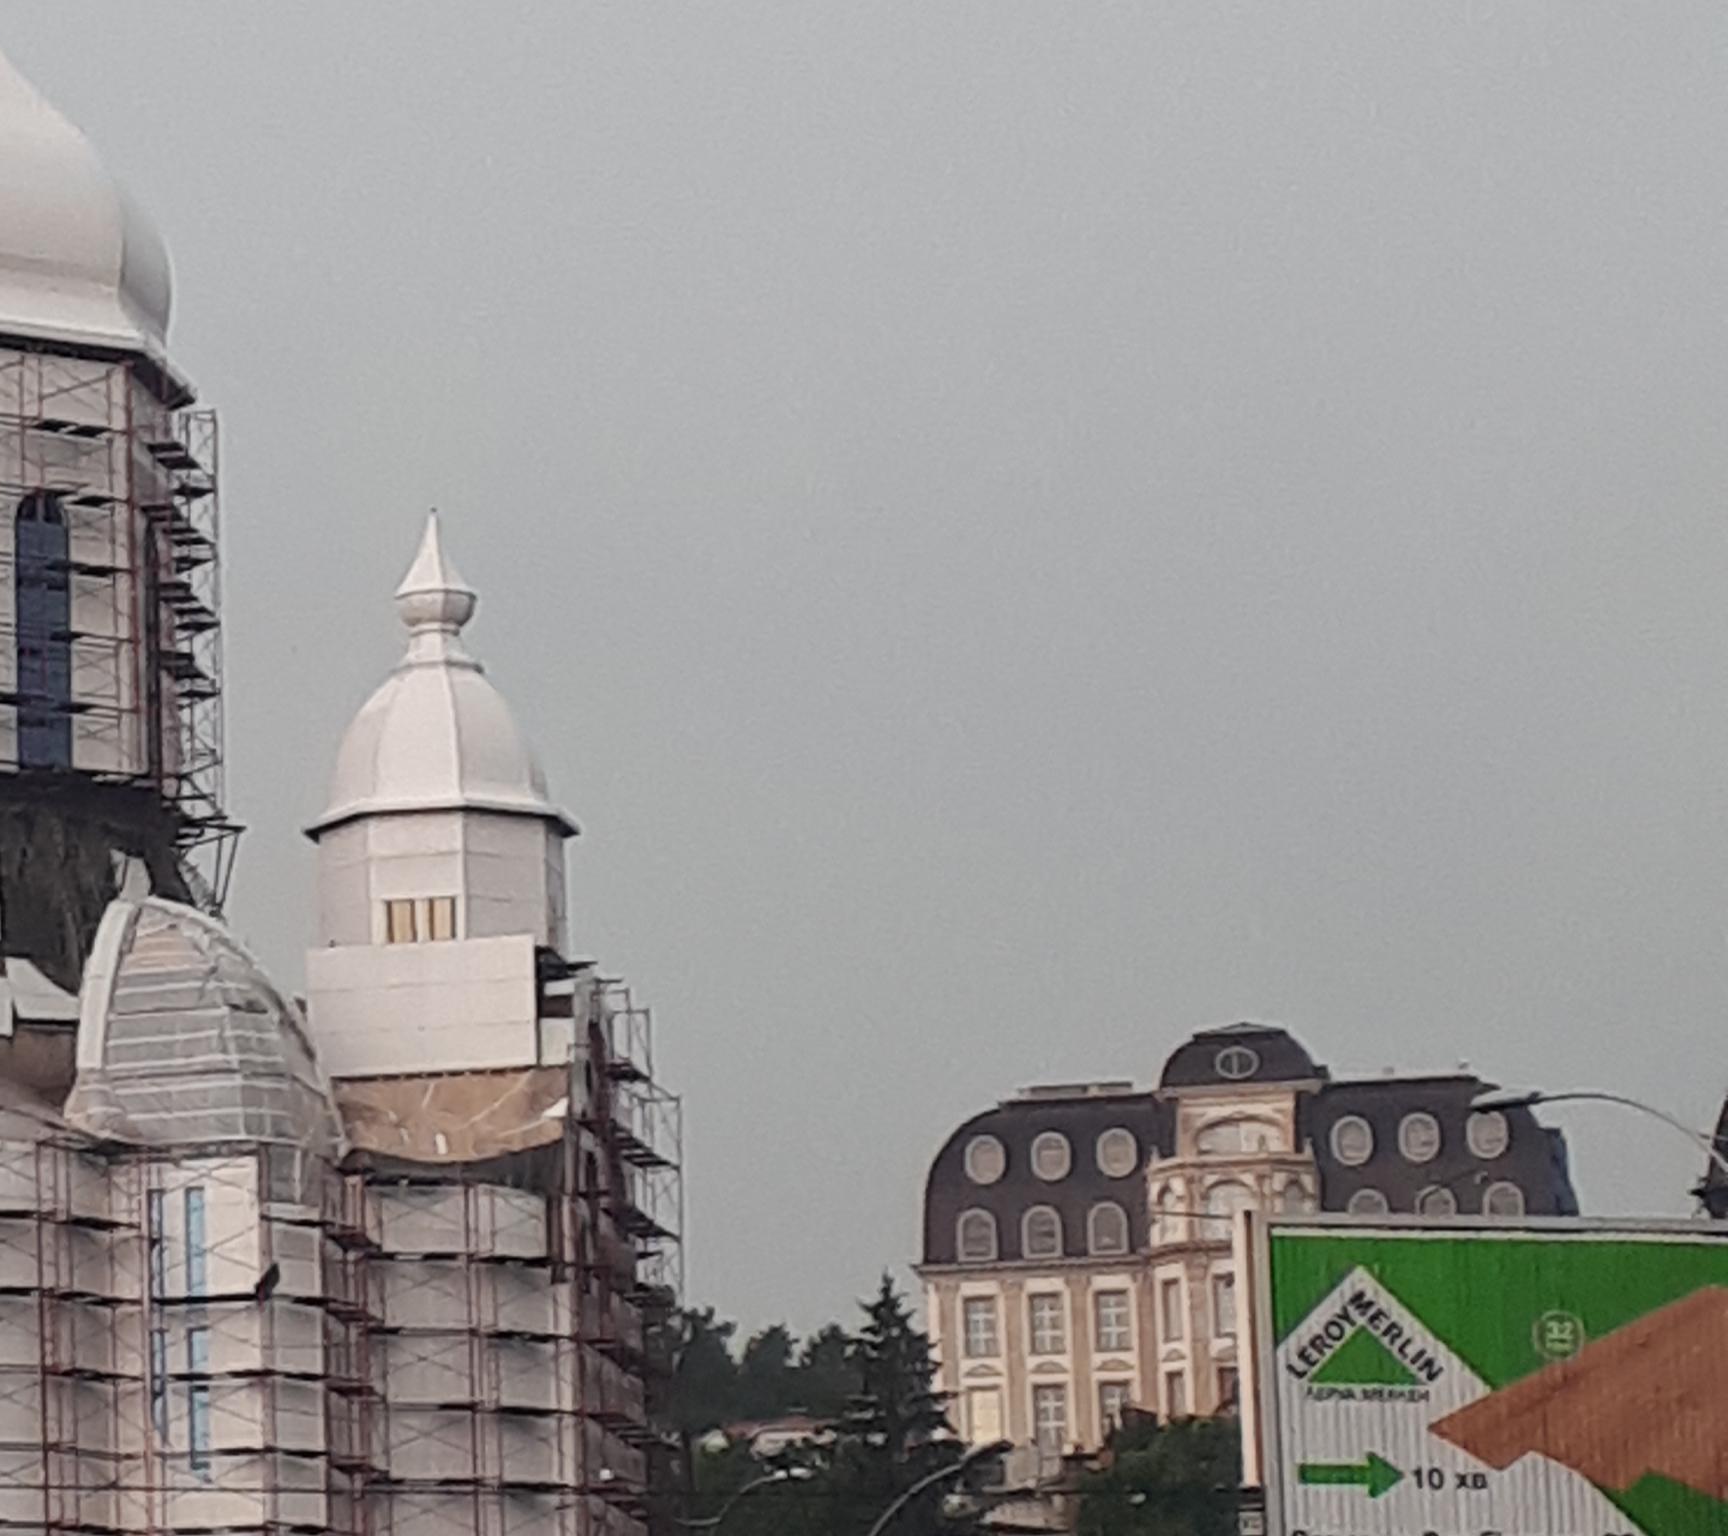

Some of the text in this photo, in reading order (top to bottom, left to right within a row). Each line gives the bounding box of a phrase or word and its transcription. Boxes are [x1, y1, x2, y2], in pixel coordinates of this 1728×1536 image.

[1286, 1305, 1357, 1380] LEROY
[1349, 1290, 1444, 1382] MERLIN
[1412, 1468, 1445, 1491] 10
